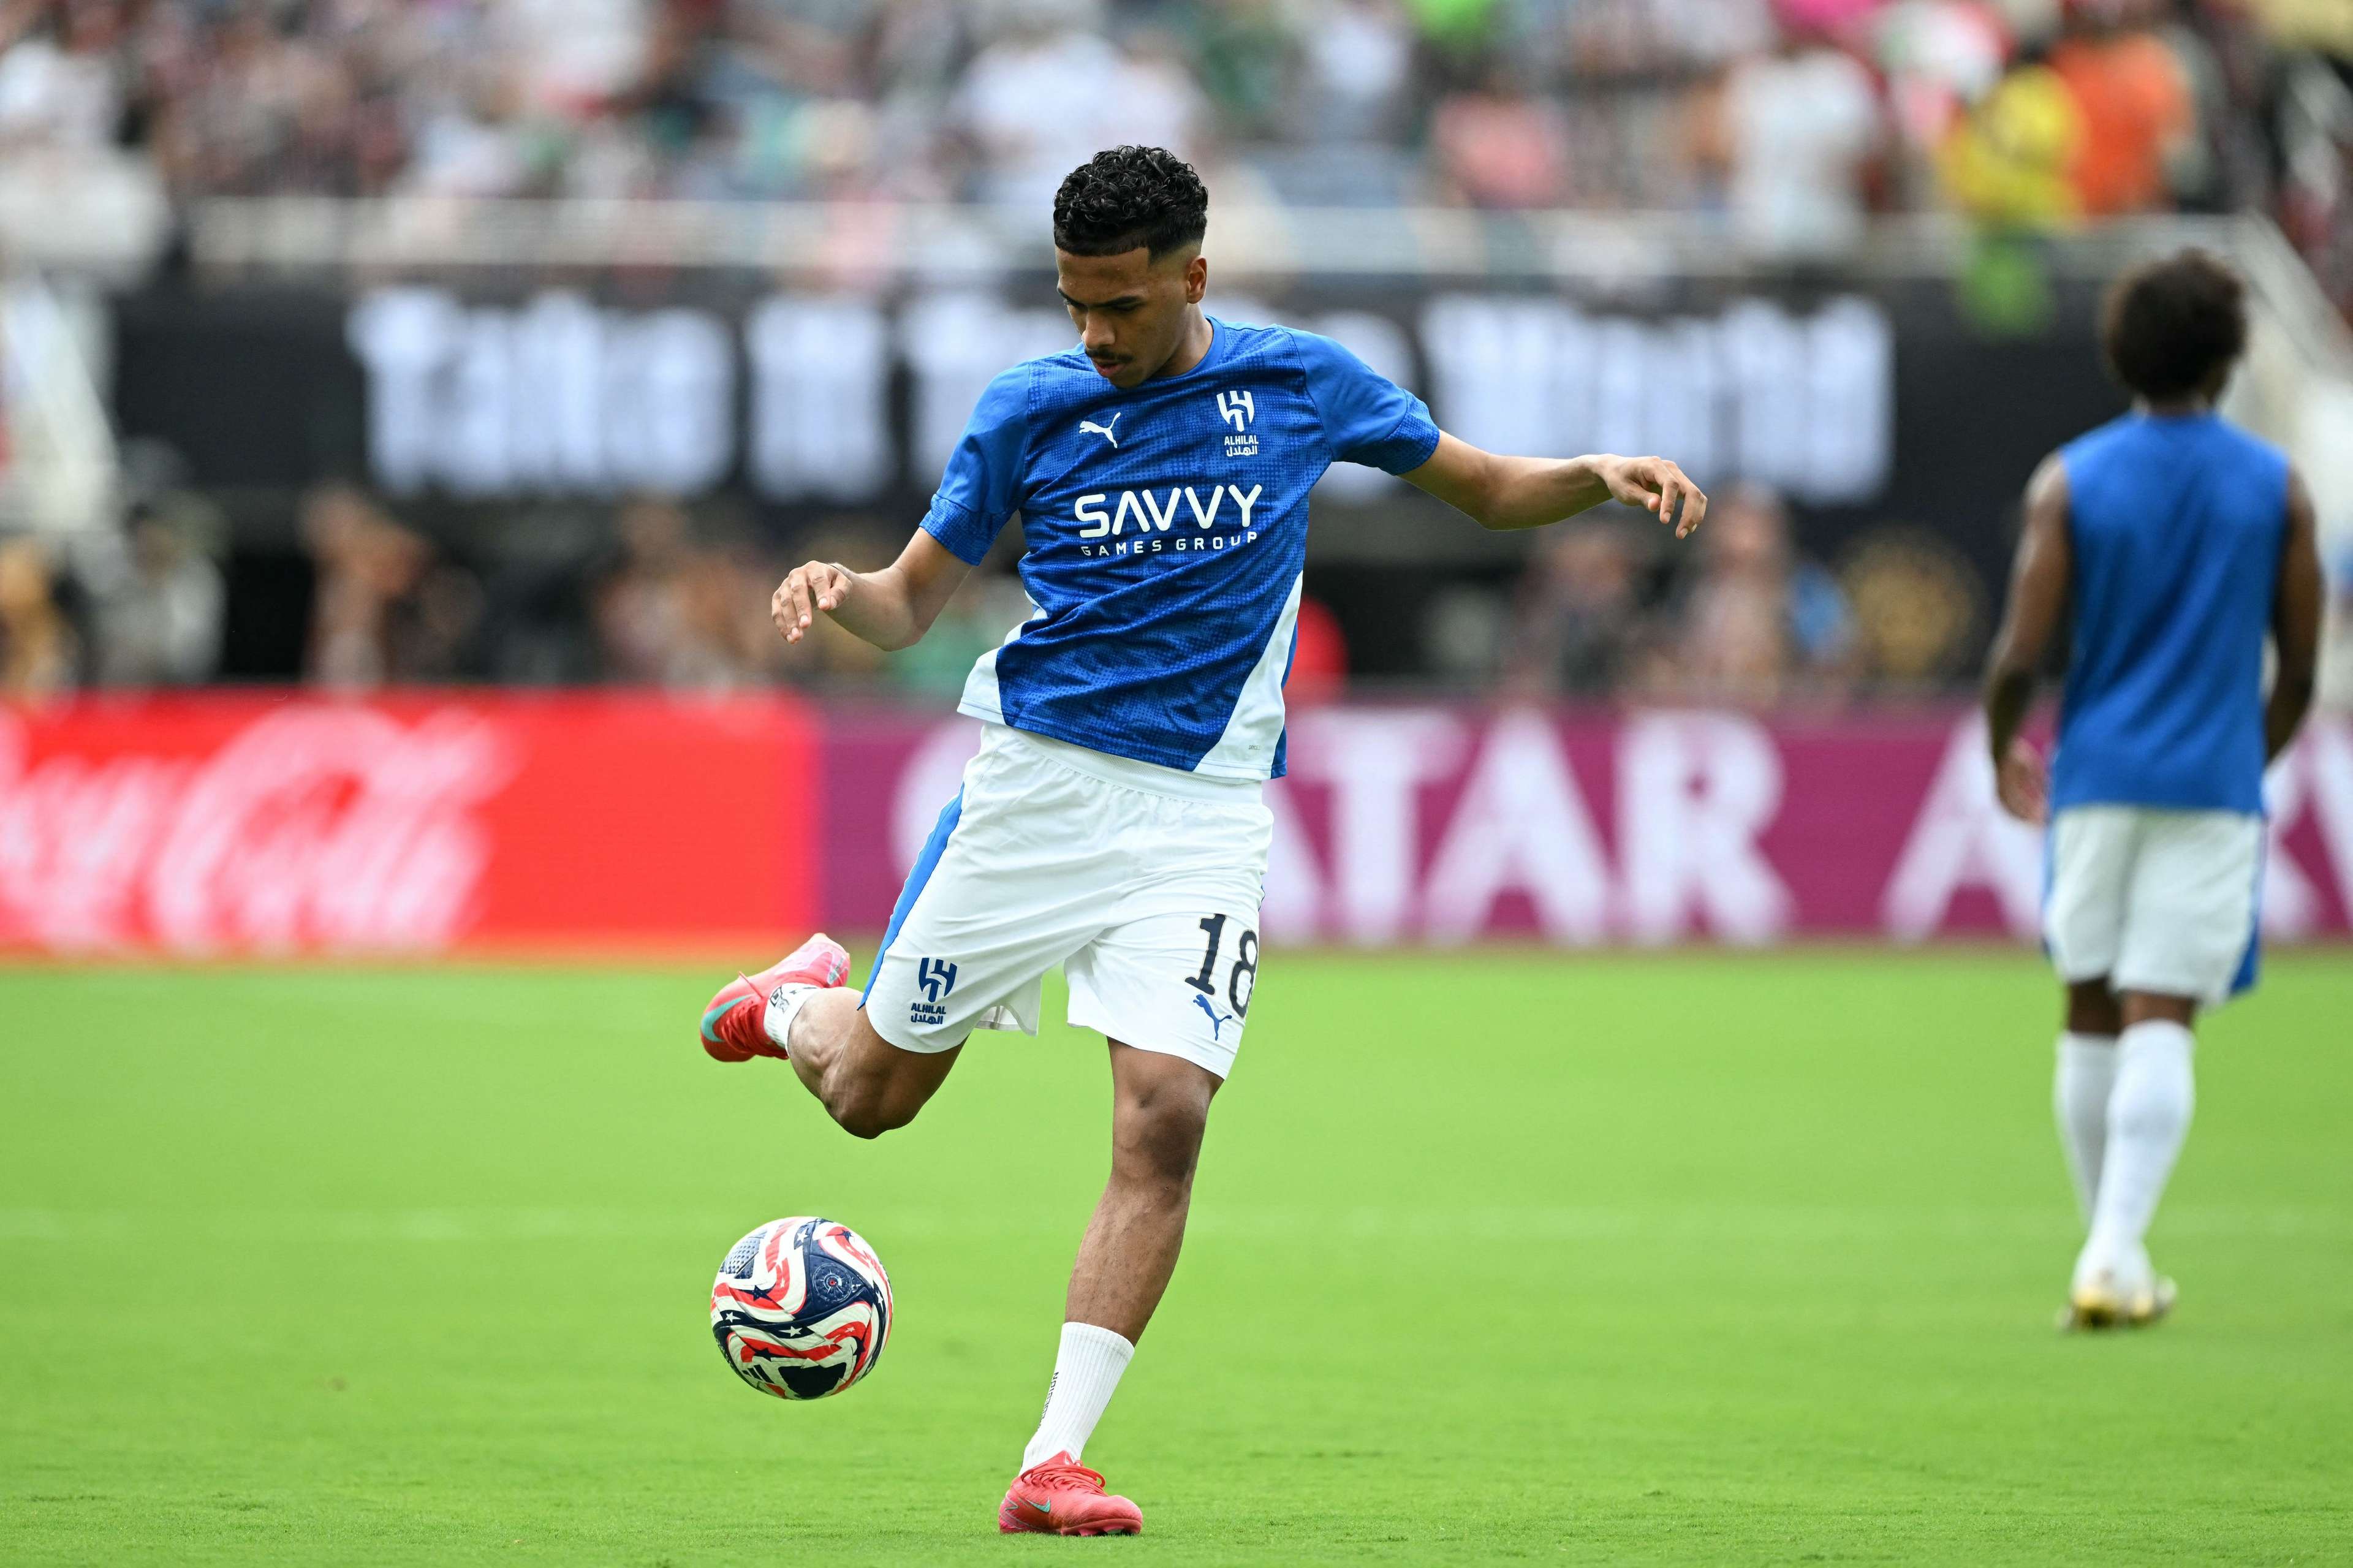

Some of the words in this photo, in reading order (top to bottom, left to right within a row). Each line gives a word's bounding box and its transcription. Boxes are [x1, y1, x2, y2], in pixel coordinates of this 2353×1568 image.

[1224, 435, 1259, 445] ALHILAL
[1226, 445, 1258, 457] الهلال
[1074, 484, 1262, 538] SAVVY
[1081, 540, 1162, 556] GAMES
[1176, 531, 1257, 551] GROUP
[1184, 913, 1258, 1018] 18
[911, 1002, 946, 1015] ALHILAL
[911, 1013, 944, 1025] الهلال
